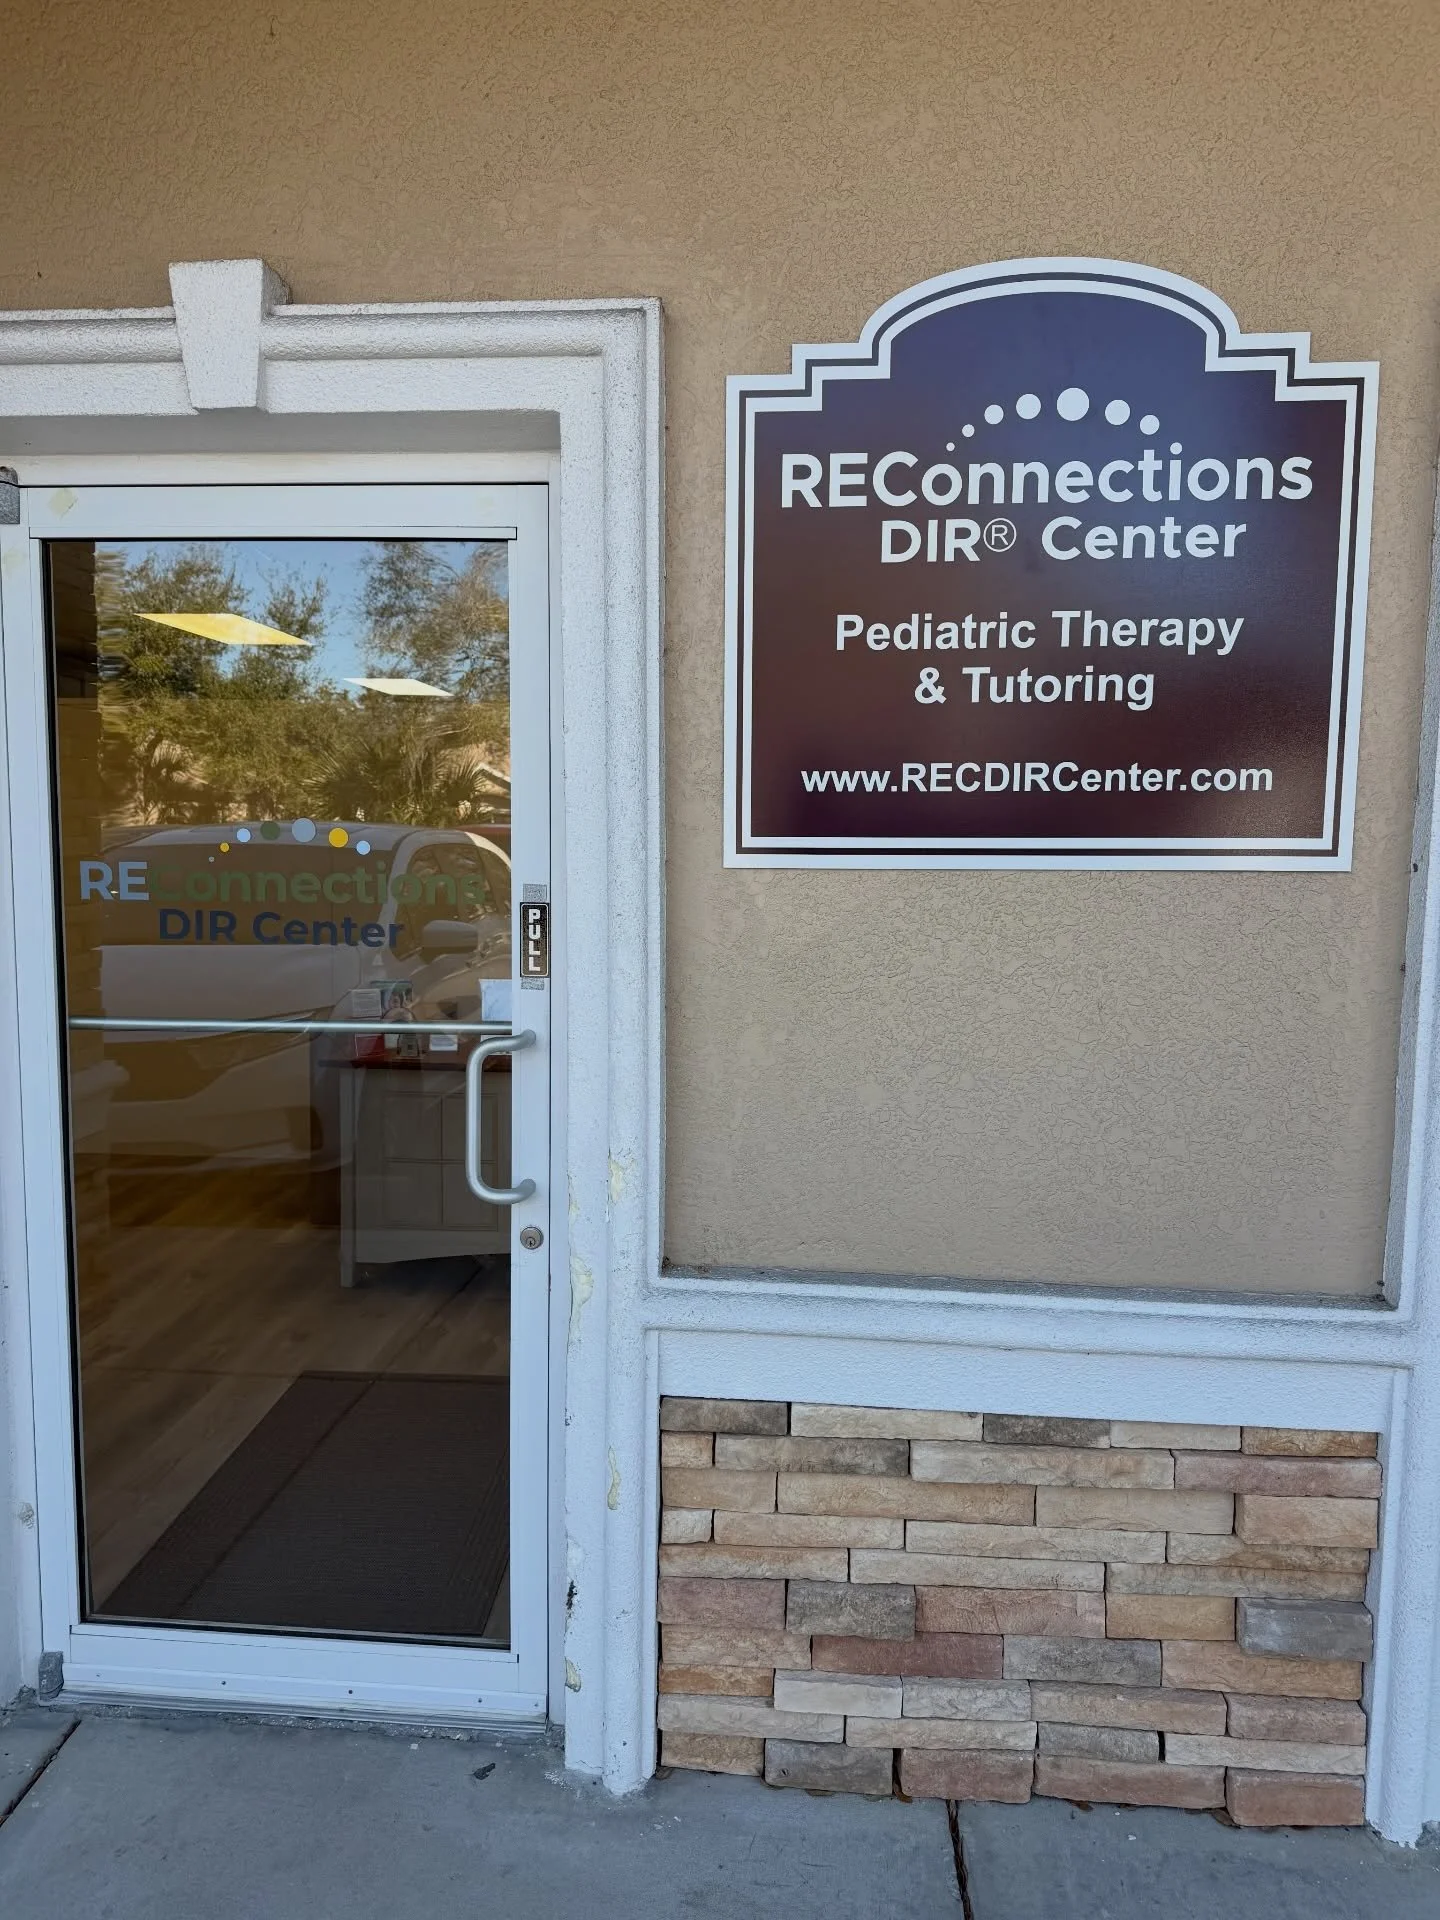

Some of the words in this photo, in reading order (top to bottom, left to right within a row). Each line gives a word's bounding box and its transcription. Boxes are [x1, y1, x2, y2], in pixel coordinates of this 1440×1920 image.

[781, 442, 1313, 508] REConnections
[1041, 515, 1247, 560] Center
[835, 612, 1036, 650] Pediatric
[1051, 610, 1245, 657] Therapy
[914, 667, 946, 704] &
[962, 665, 1155, 711] Tutoring
[801, 761, 1273, 794] www.RECDIRCenter.com
[79, 860, 486, 905] REConnections
[158, 908, 236, 943] DIR
[252, 911, 404, 948] Center
[528, 908, 541, 972] PULL
